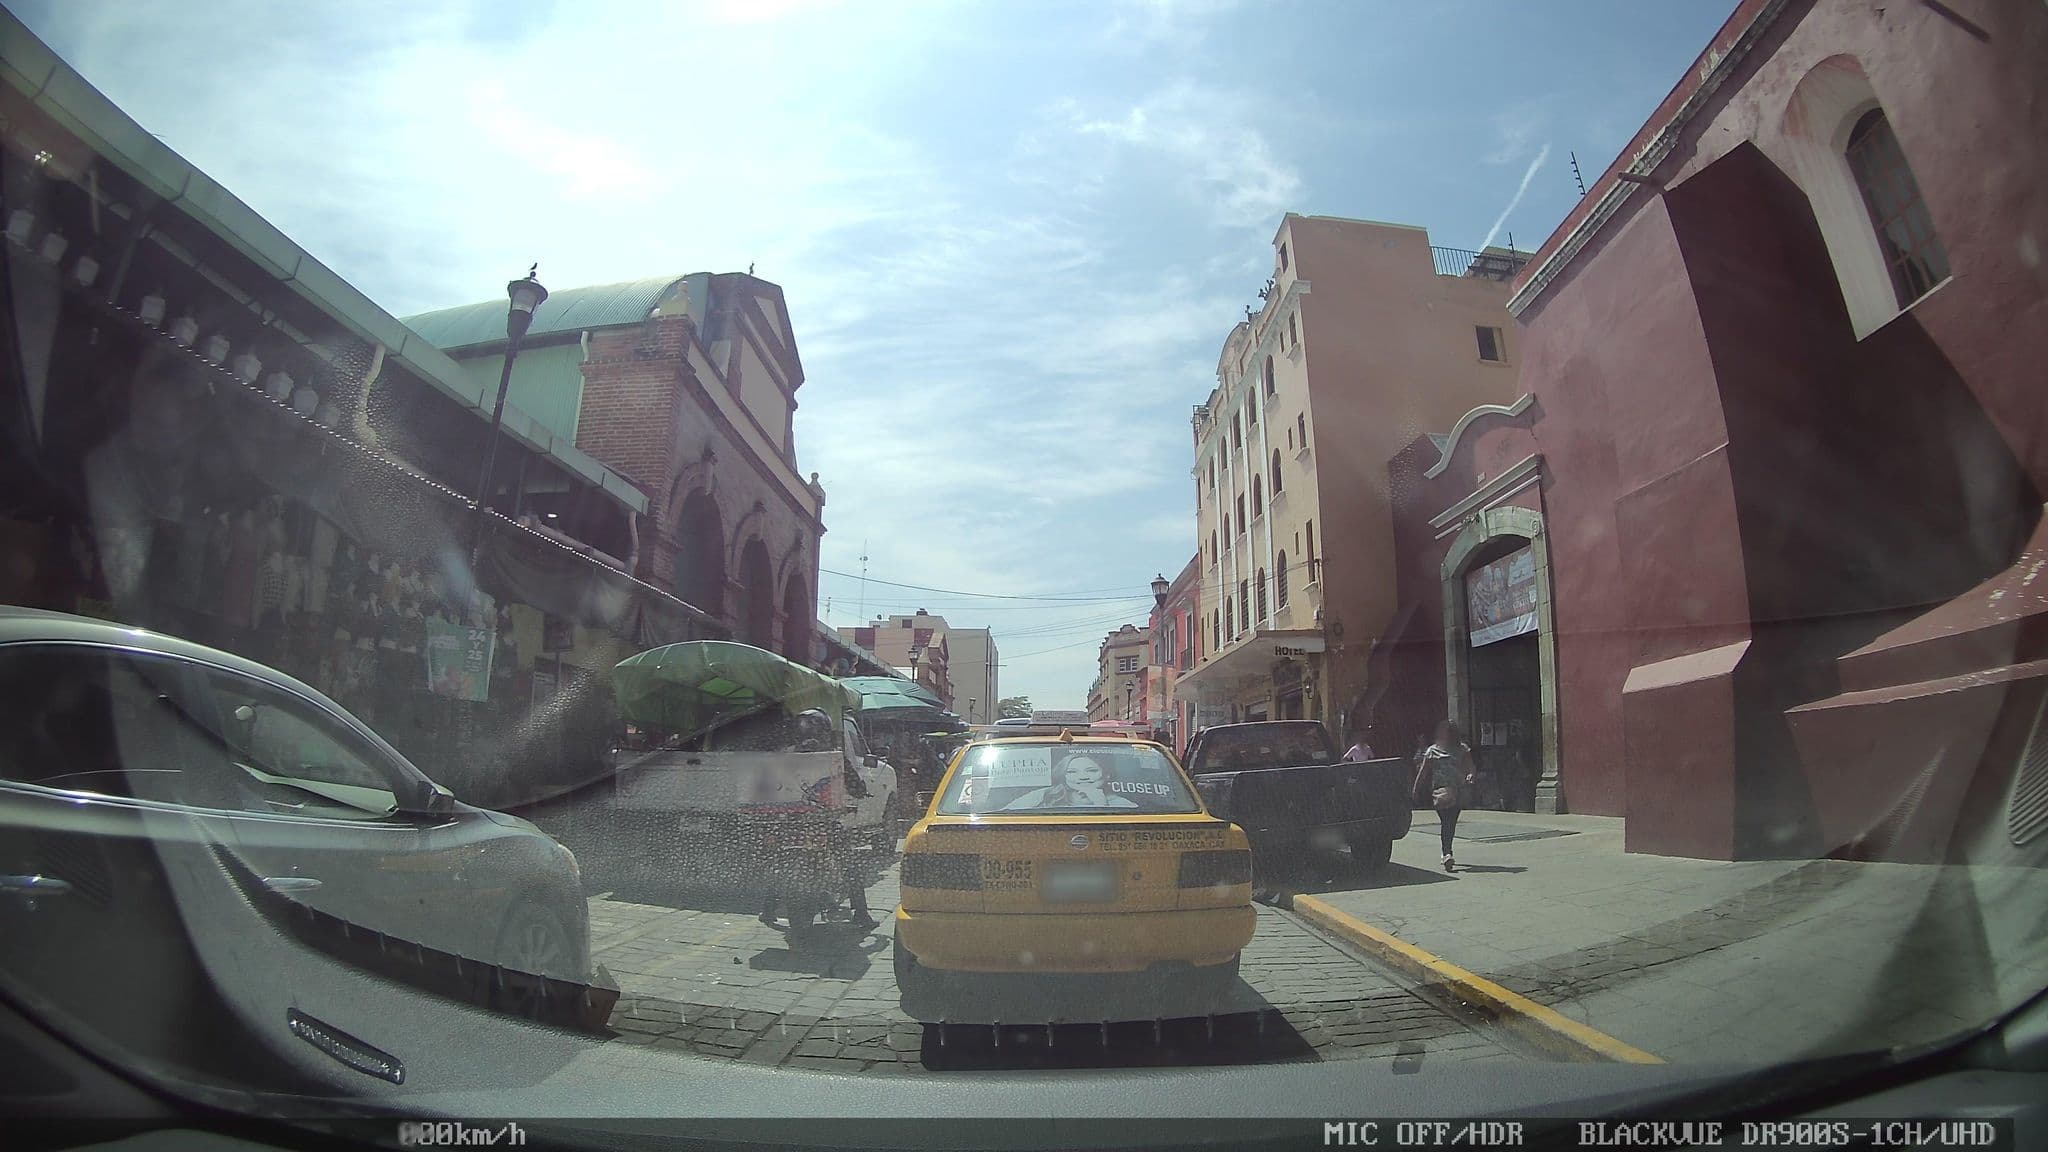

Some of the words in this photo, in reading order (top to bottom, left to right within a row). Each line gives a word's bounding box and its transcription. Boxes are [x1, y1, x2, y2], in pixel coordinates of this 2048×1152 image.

[1275, 646, 1305, 656] HOTEL
[1112, 781, 1152, 794] CLOSE
[1153, 784, 1170, 796] UP
[1099, 831, 1127, 842] SITIO
